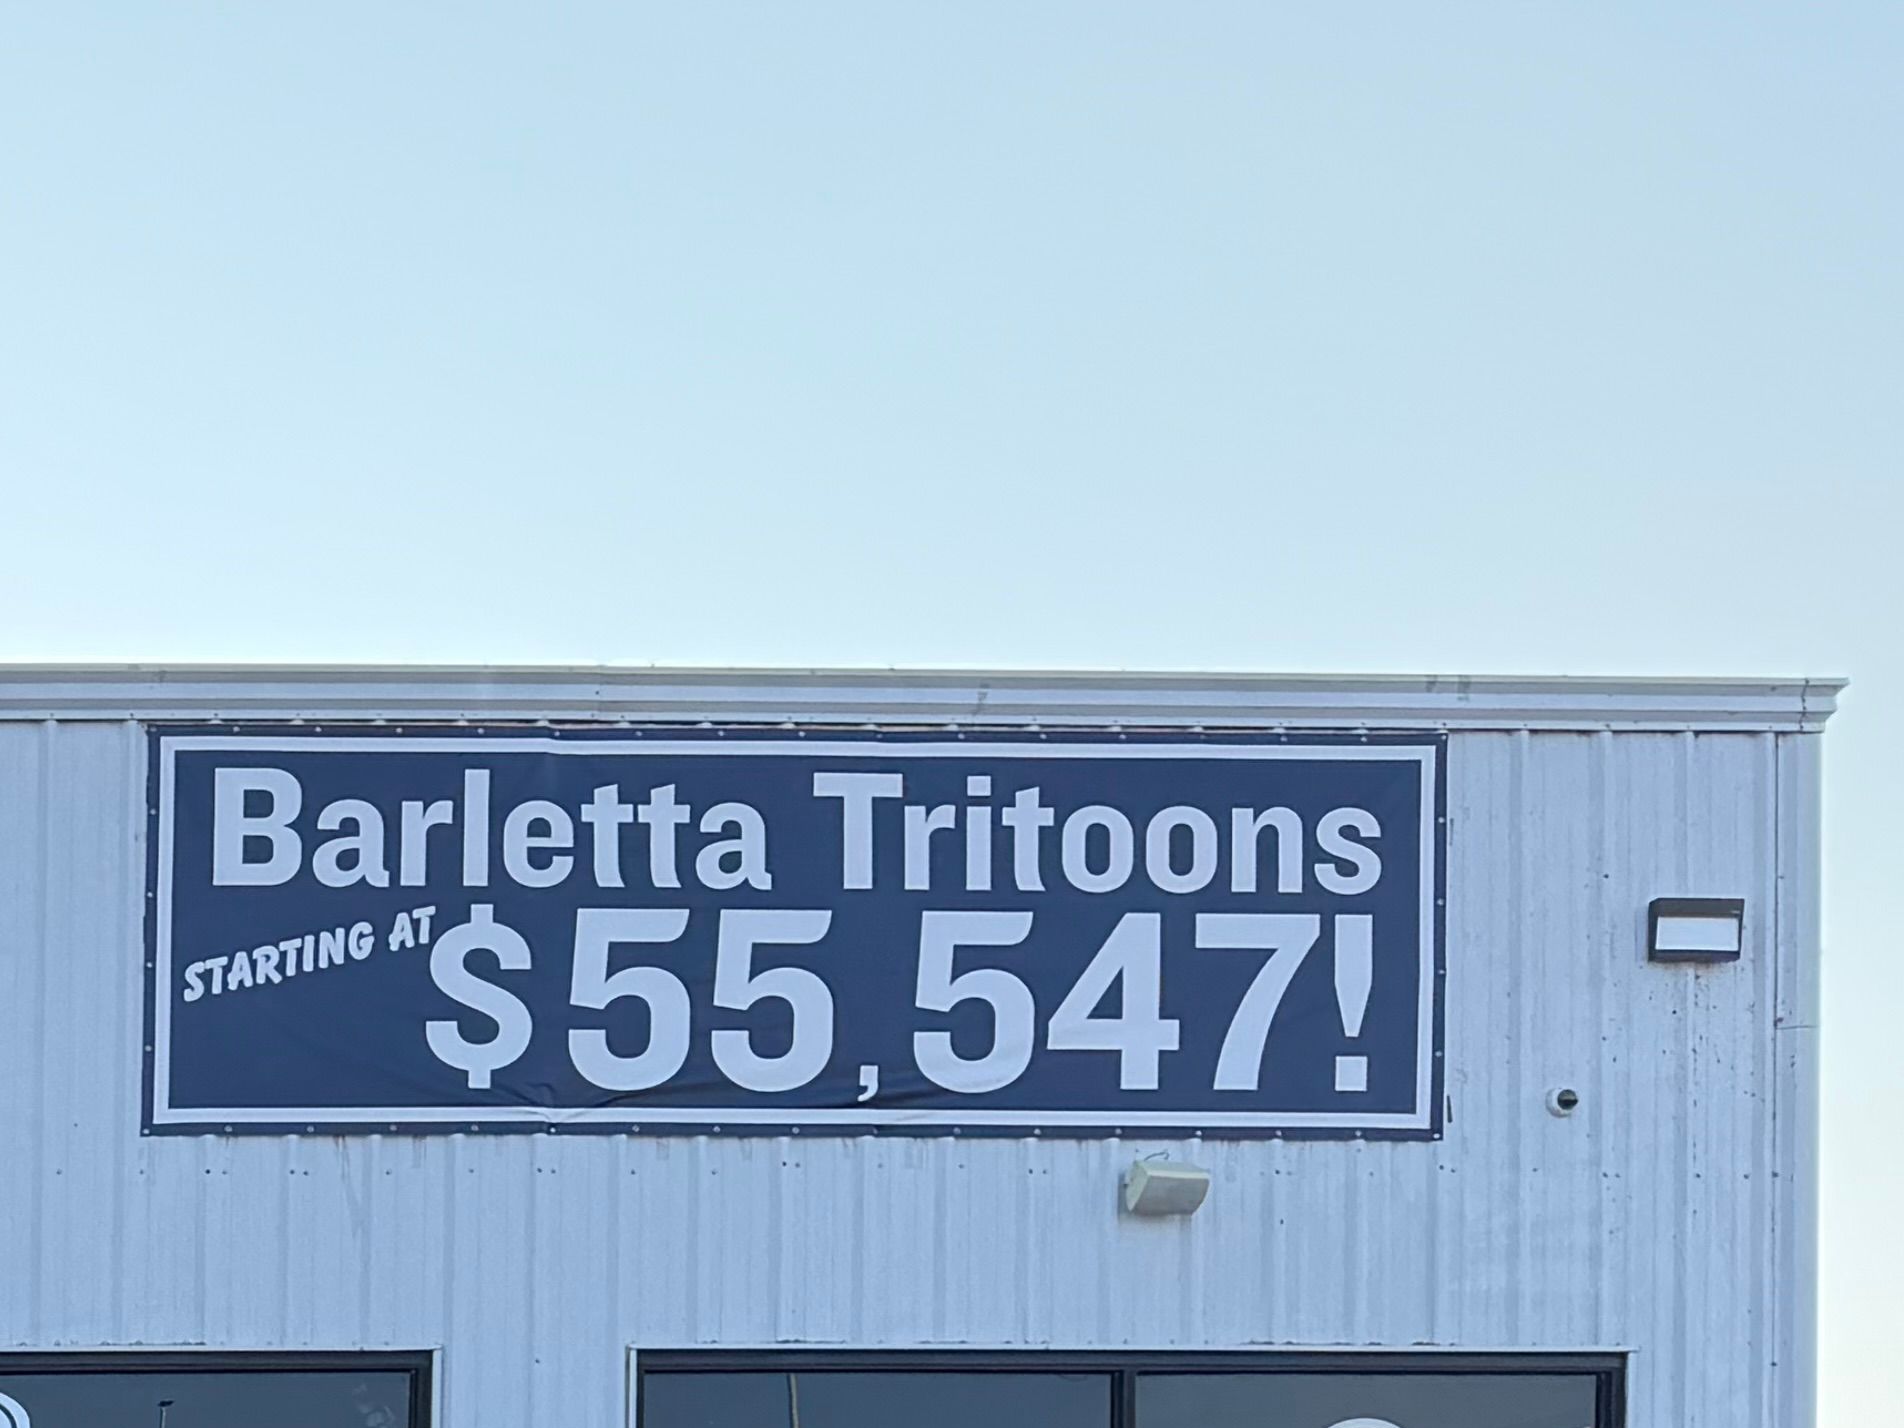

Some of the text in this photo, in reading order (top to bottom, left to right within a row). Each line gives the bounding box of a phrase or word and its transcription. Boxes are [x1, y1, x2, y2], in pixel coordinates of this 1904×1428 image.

[211, 767, 1384, 897] Barletta Tritoons
[184, 905, 436, 1002] STARTING AT
[425, 903, 1370, 1104] $55,547!
